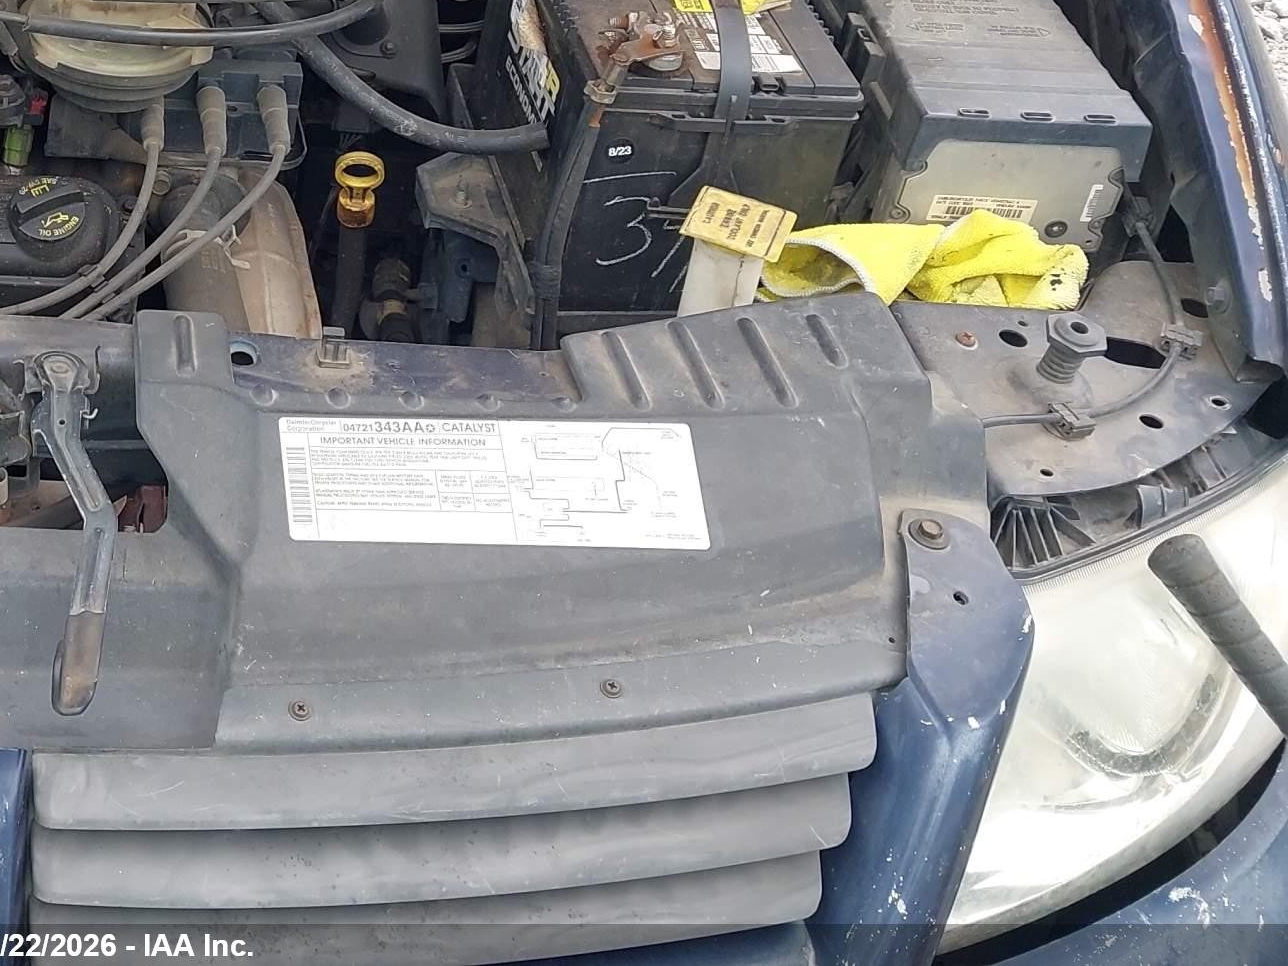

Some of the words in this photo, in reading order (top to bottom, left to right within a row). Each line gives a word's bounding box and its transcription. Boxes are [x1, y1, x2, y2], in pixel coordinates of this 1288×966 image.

[608, 145, 633, 157] 8/23
[53, 216, 80, 236] ENGINE
[37, 228, 52, 237] OIL
[441, 422, 497, 433] CATALYST
[320, 436, 375, 445] IMPORTANT
[376, 437, 416, 446] VEHICLE
[418, 438, 486, 447] INFORMATION
